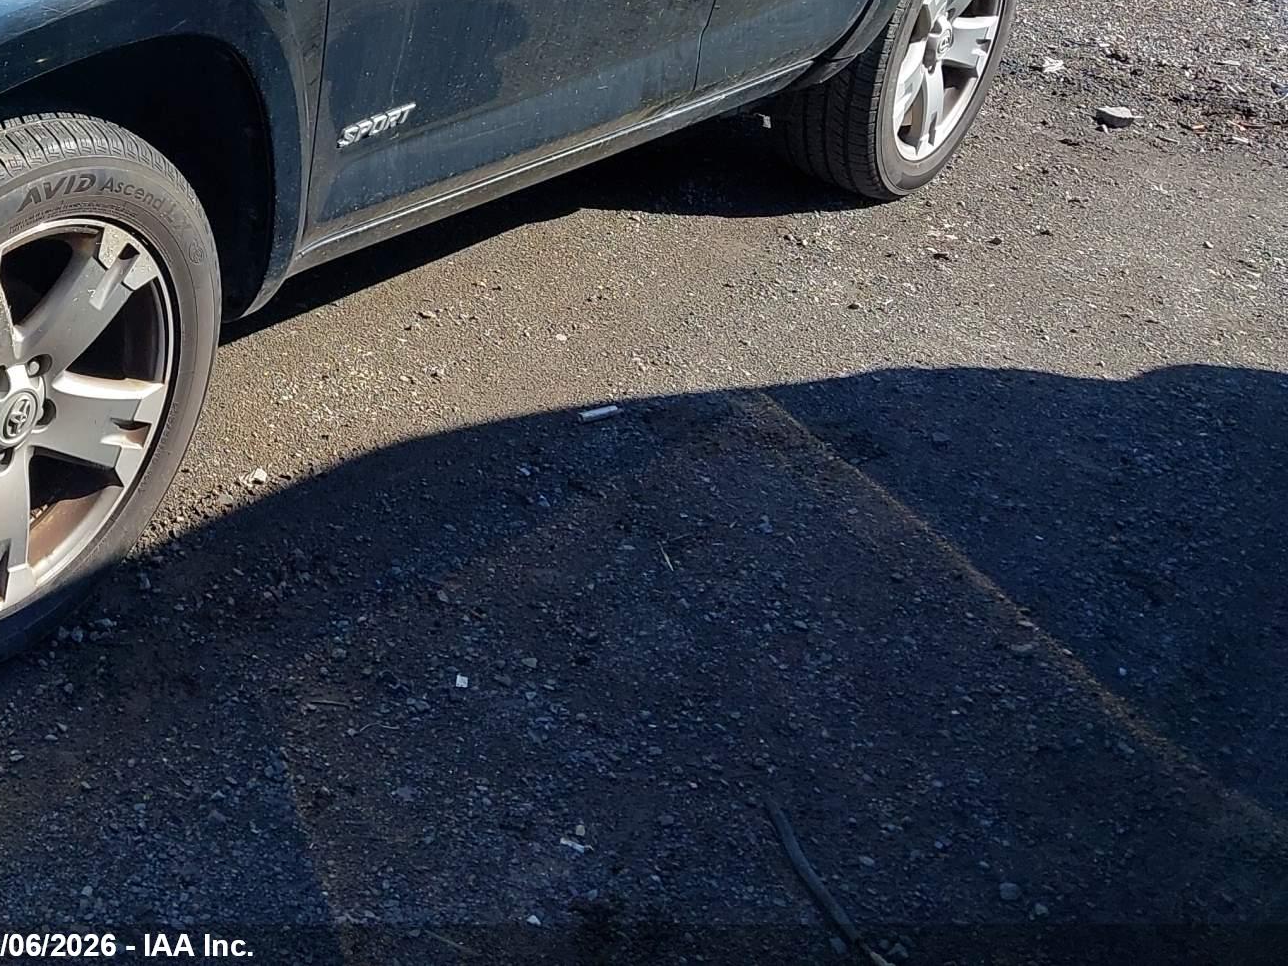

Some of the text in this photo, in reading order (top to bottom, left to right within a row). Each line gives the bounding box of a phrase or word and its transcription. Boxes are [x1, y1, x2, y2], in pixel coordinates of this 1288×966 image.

[336, 102, 416, 148] SPORT
[16, 173, 96, 212] AVID
[100, 176, 166, 212] Ascend
